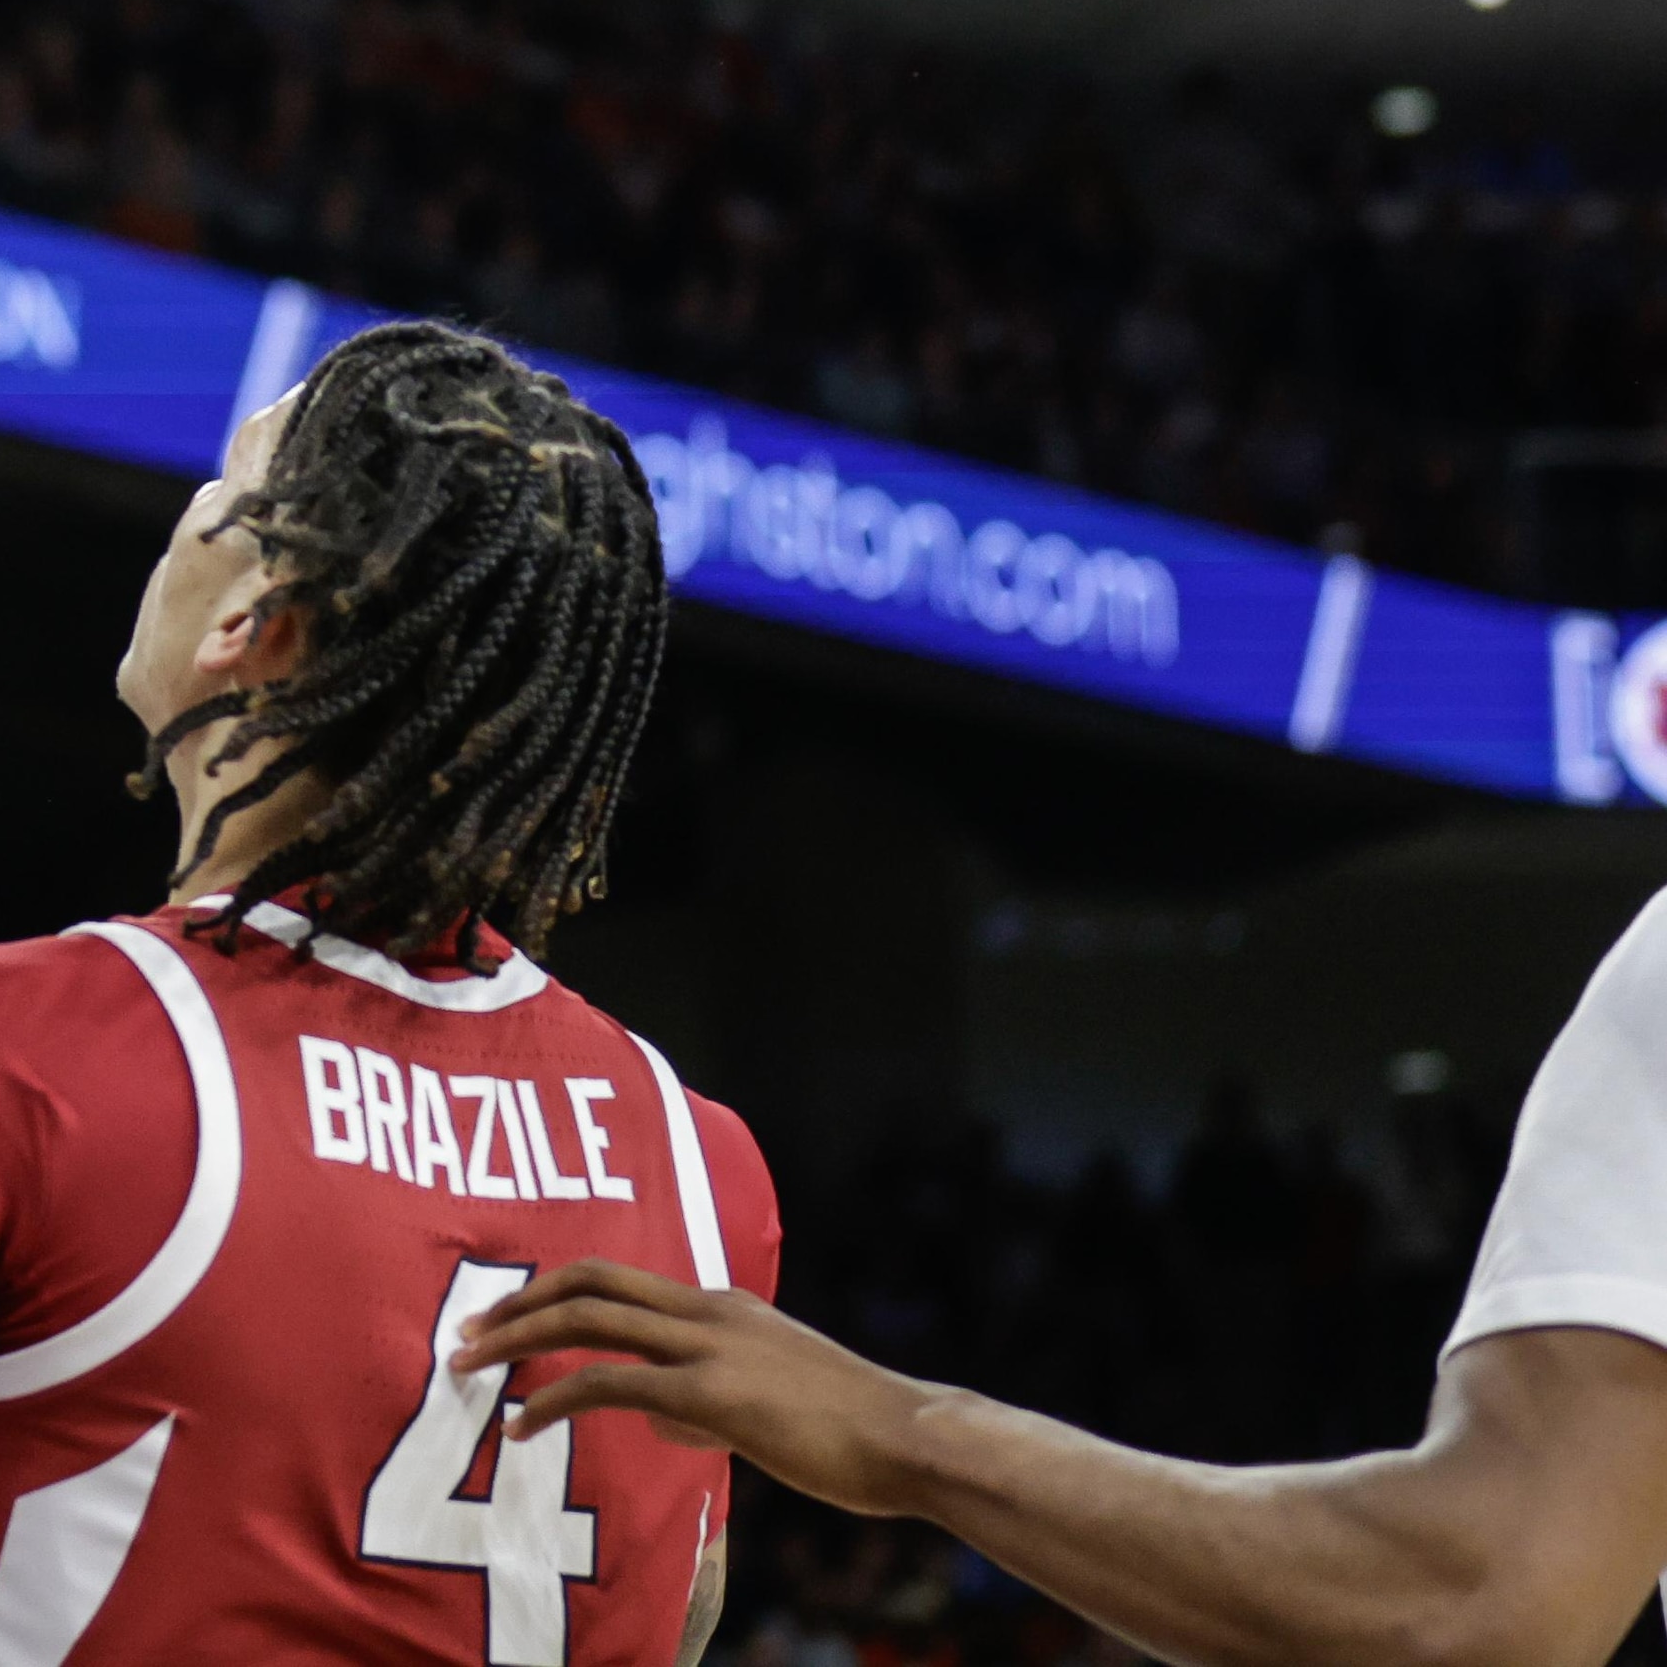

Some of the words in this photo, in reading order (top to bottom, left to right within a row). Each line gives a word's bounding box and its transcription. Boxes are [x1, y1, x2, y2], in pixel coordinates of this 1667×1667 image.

[628, 416, 1179, 669] ghston.com
[298, 1034, 636, 1203] BRAZILE
[358, 1258, 598, 1667] 4
